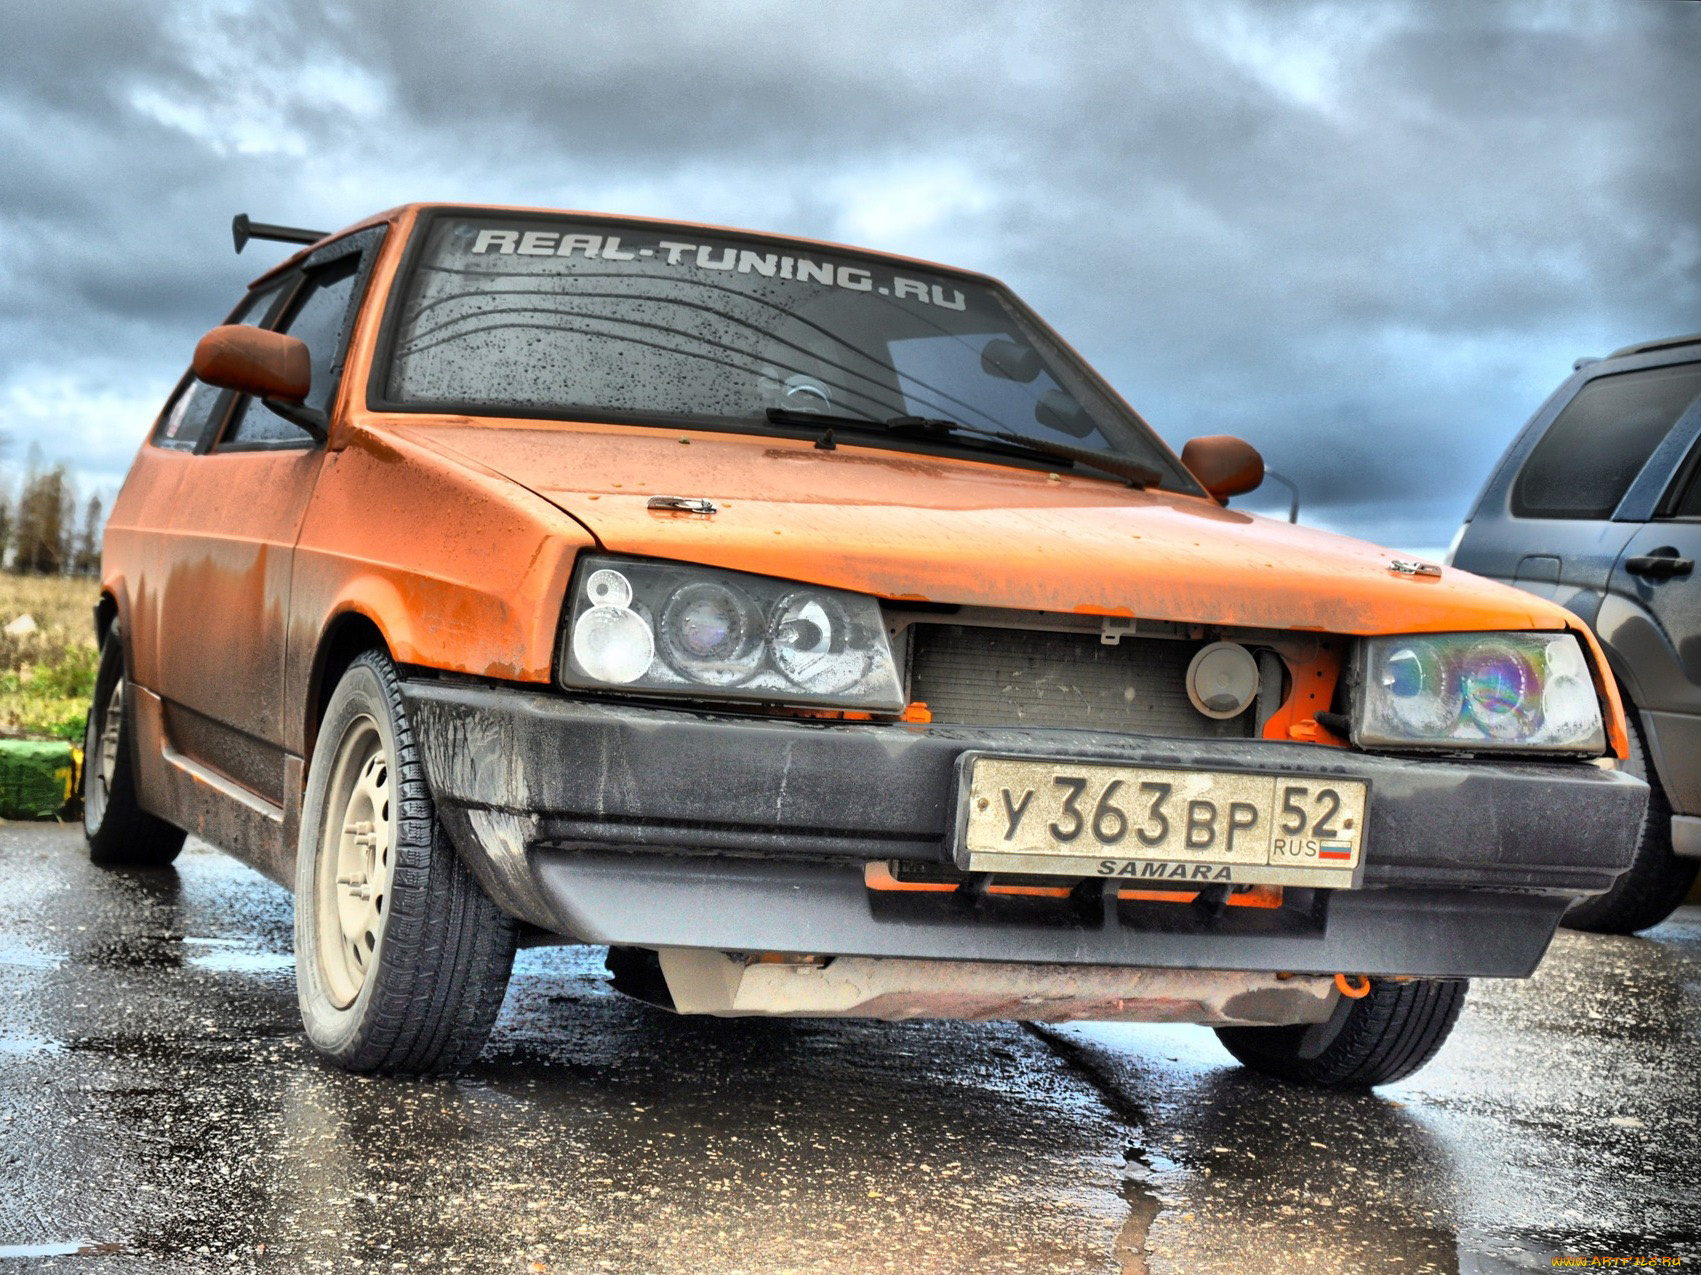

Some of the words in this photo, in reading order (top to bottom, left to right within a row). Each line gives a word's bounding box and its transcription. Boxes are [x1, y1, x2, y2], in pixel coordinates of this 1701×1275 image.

[472, 229, 967, 311] REAL-TUNING.RU
[1281, 787, 1341, 837] 52
[1273, 839, 1318, 857] RUS
[1096, 860, 1233, 881] SAMARA
